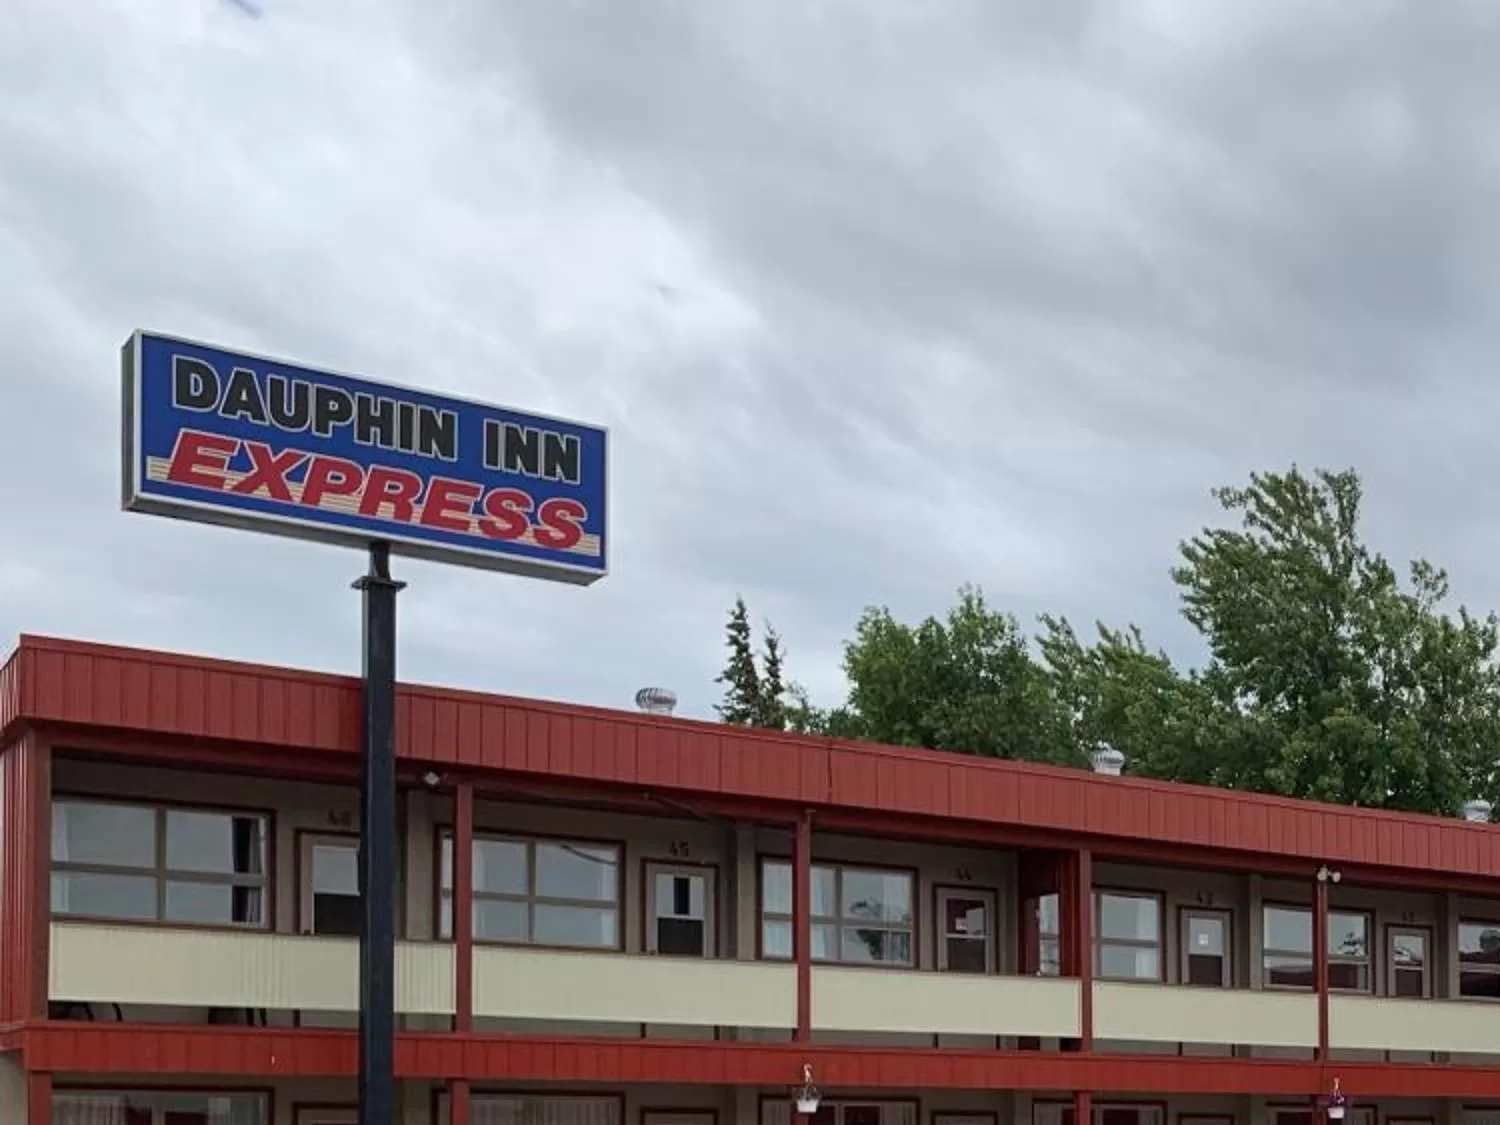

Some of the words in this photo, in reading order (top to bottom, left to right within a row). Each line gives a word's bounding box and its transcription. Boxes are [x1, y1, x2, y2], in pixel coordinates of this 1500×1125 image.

[172, 354, 458, 461] DAUPHIN
[484, 418, 581, 484] INN
[167, 428, 587, 549] EXPRESS
